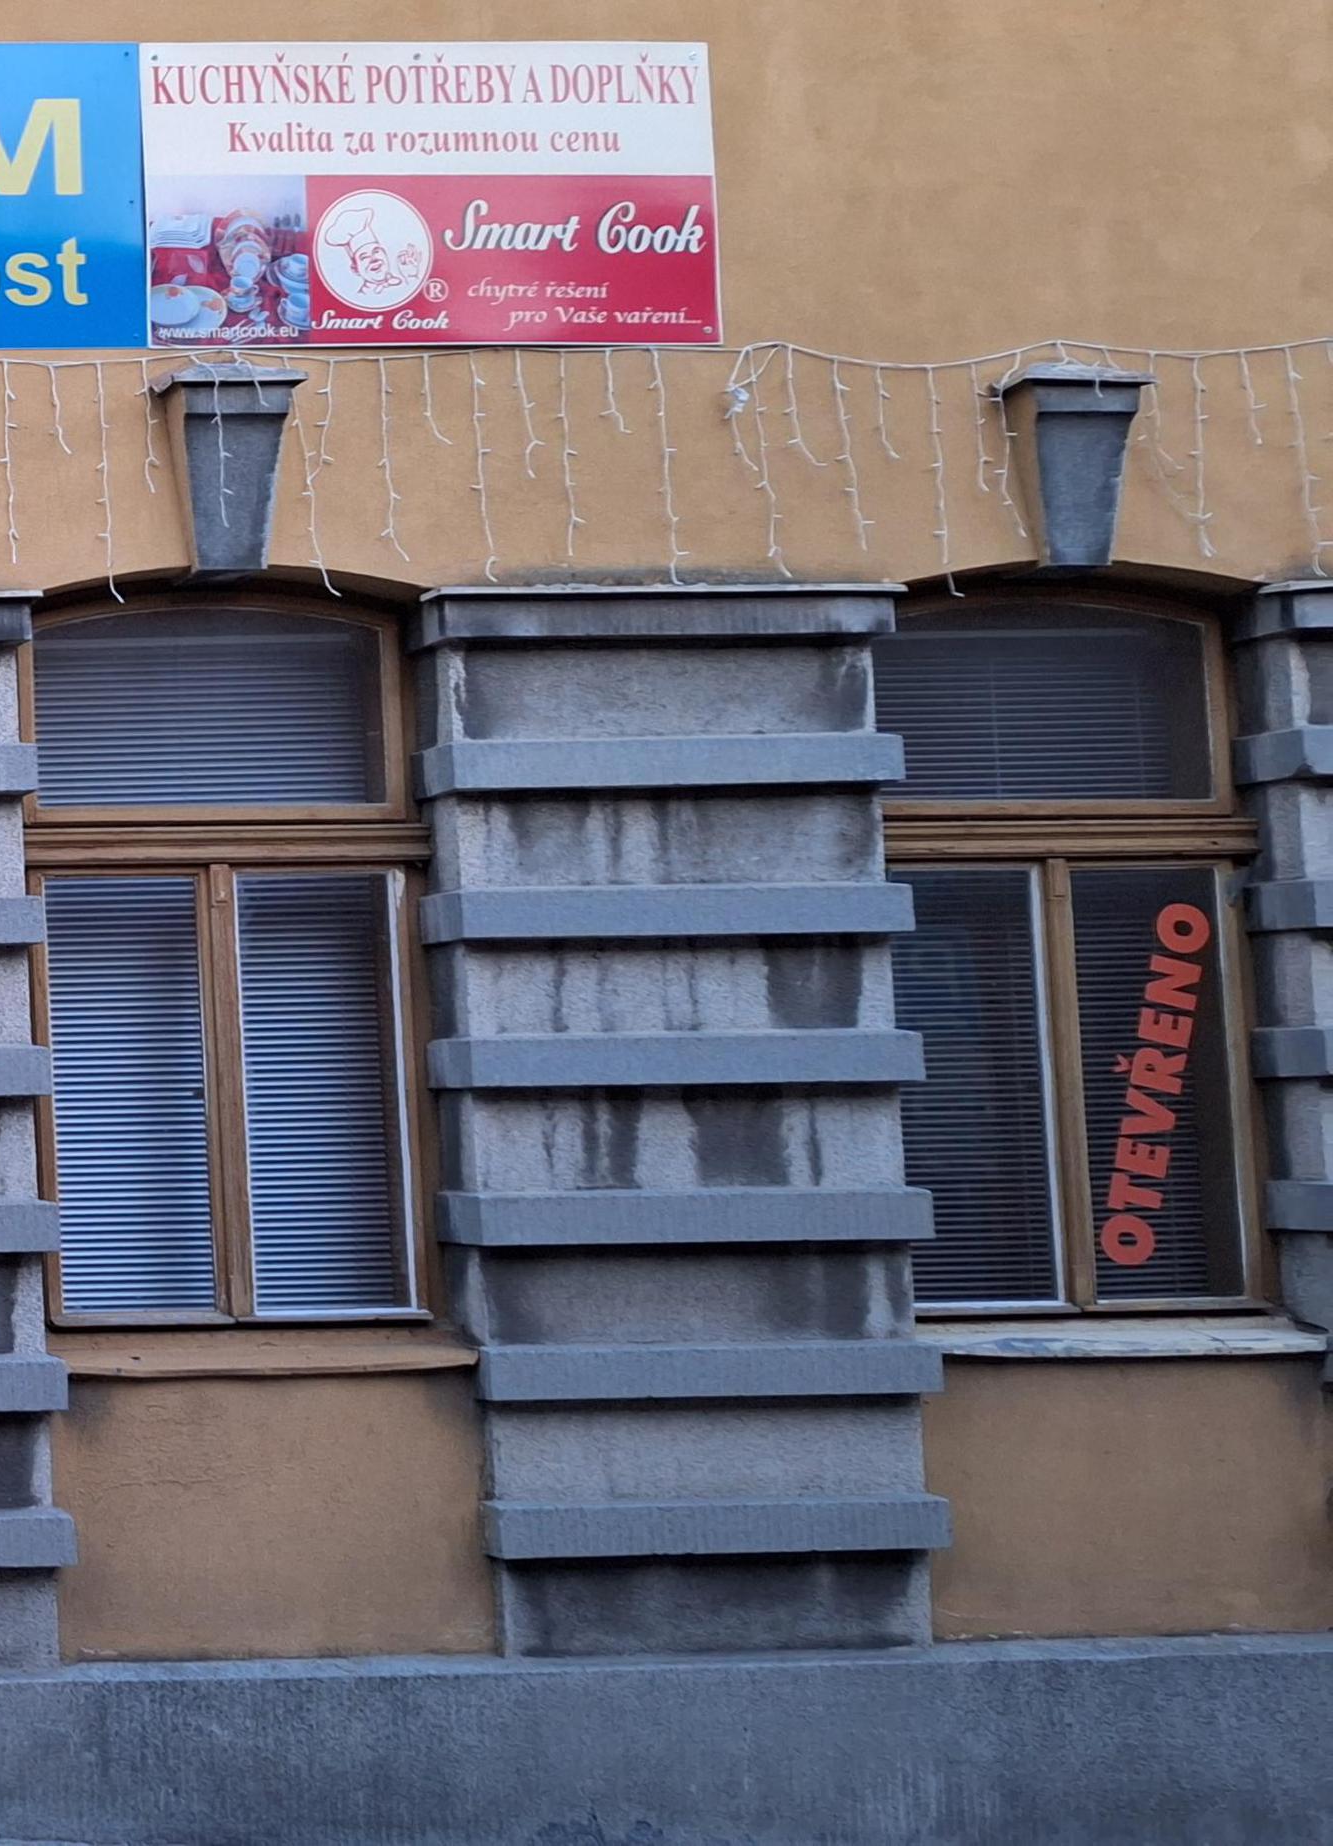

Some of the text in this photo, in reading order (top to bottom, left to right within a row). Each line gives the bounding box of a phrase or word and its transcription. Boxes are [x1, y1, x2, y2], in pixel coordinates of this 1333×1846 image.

[151, 53, 699, 105] KUCHYŇSKÉ POTŘEBY A DOPLŇKY
[227, 122, 621, 155] Kvalita za rozumnou cenu
[444, 199, 707, 254] Smart Cook
[467, 277, 610, 305] chytré řešení
[157, 323, 300, 339] www.smartcook.eu
[311, 308, 450, 330] Smart Cook
[503, 307, 548, 331] pro
[554, 306, 607, 324] Vaše
[1100, 902, 1211, 1266] OTEVŘENO
